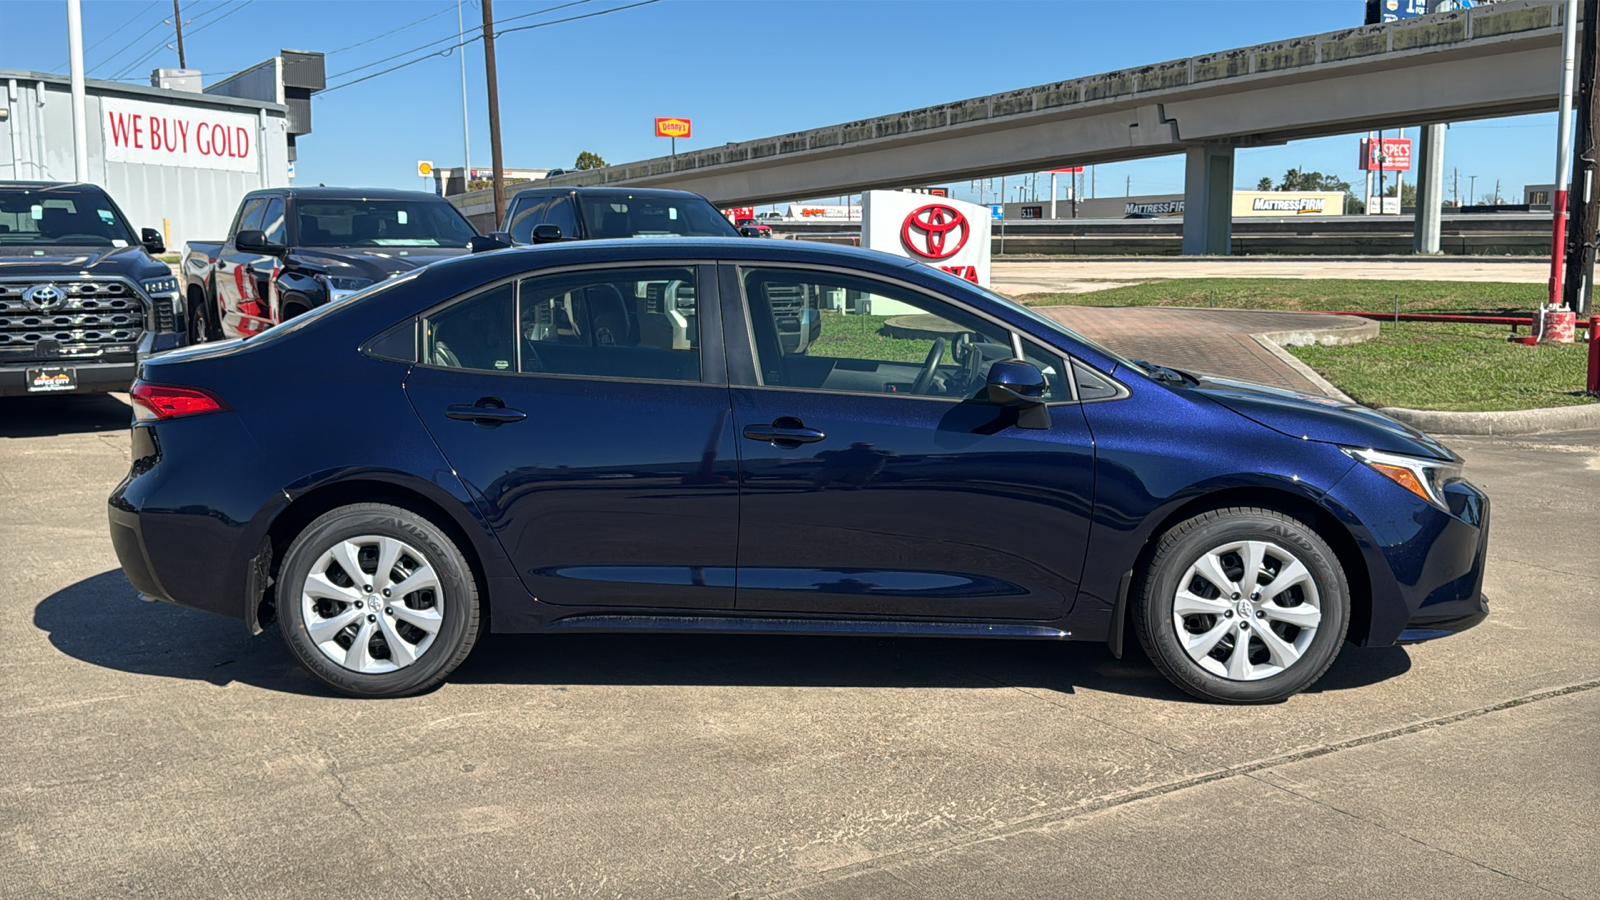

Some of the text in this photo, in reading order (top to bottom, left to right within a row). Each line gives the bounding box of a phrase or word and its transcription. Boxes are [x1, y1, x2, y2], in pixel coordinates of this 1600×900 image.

[108, 111, 249, 159] WE BUY GOLD
[662, 122, 687, 132] Denny's
[380, 517, 429, 541] AVID
[1265, 524, 1314, 552] AVID
